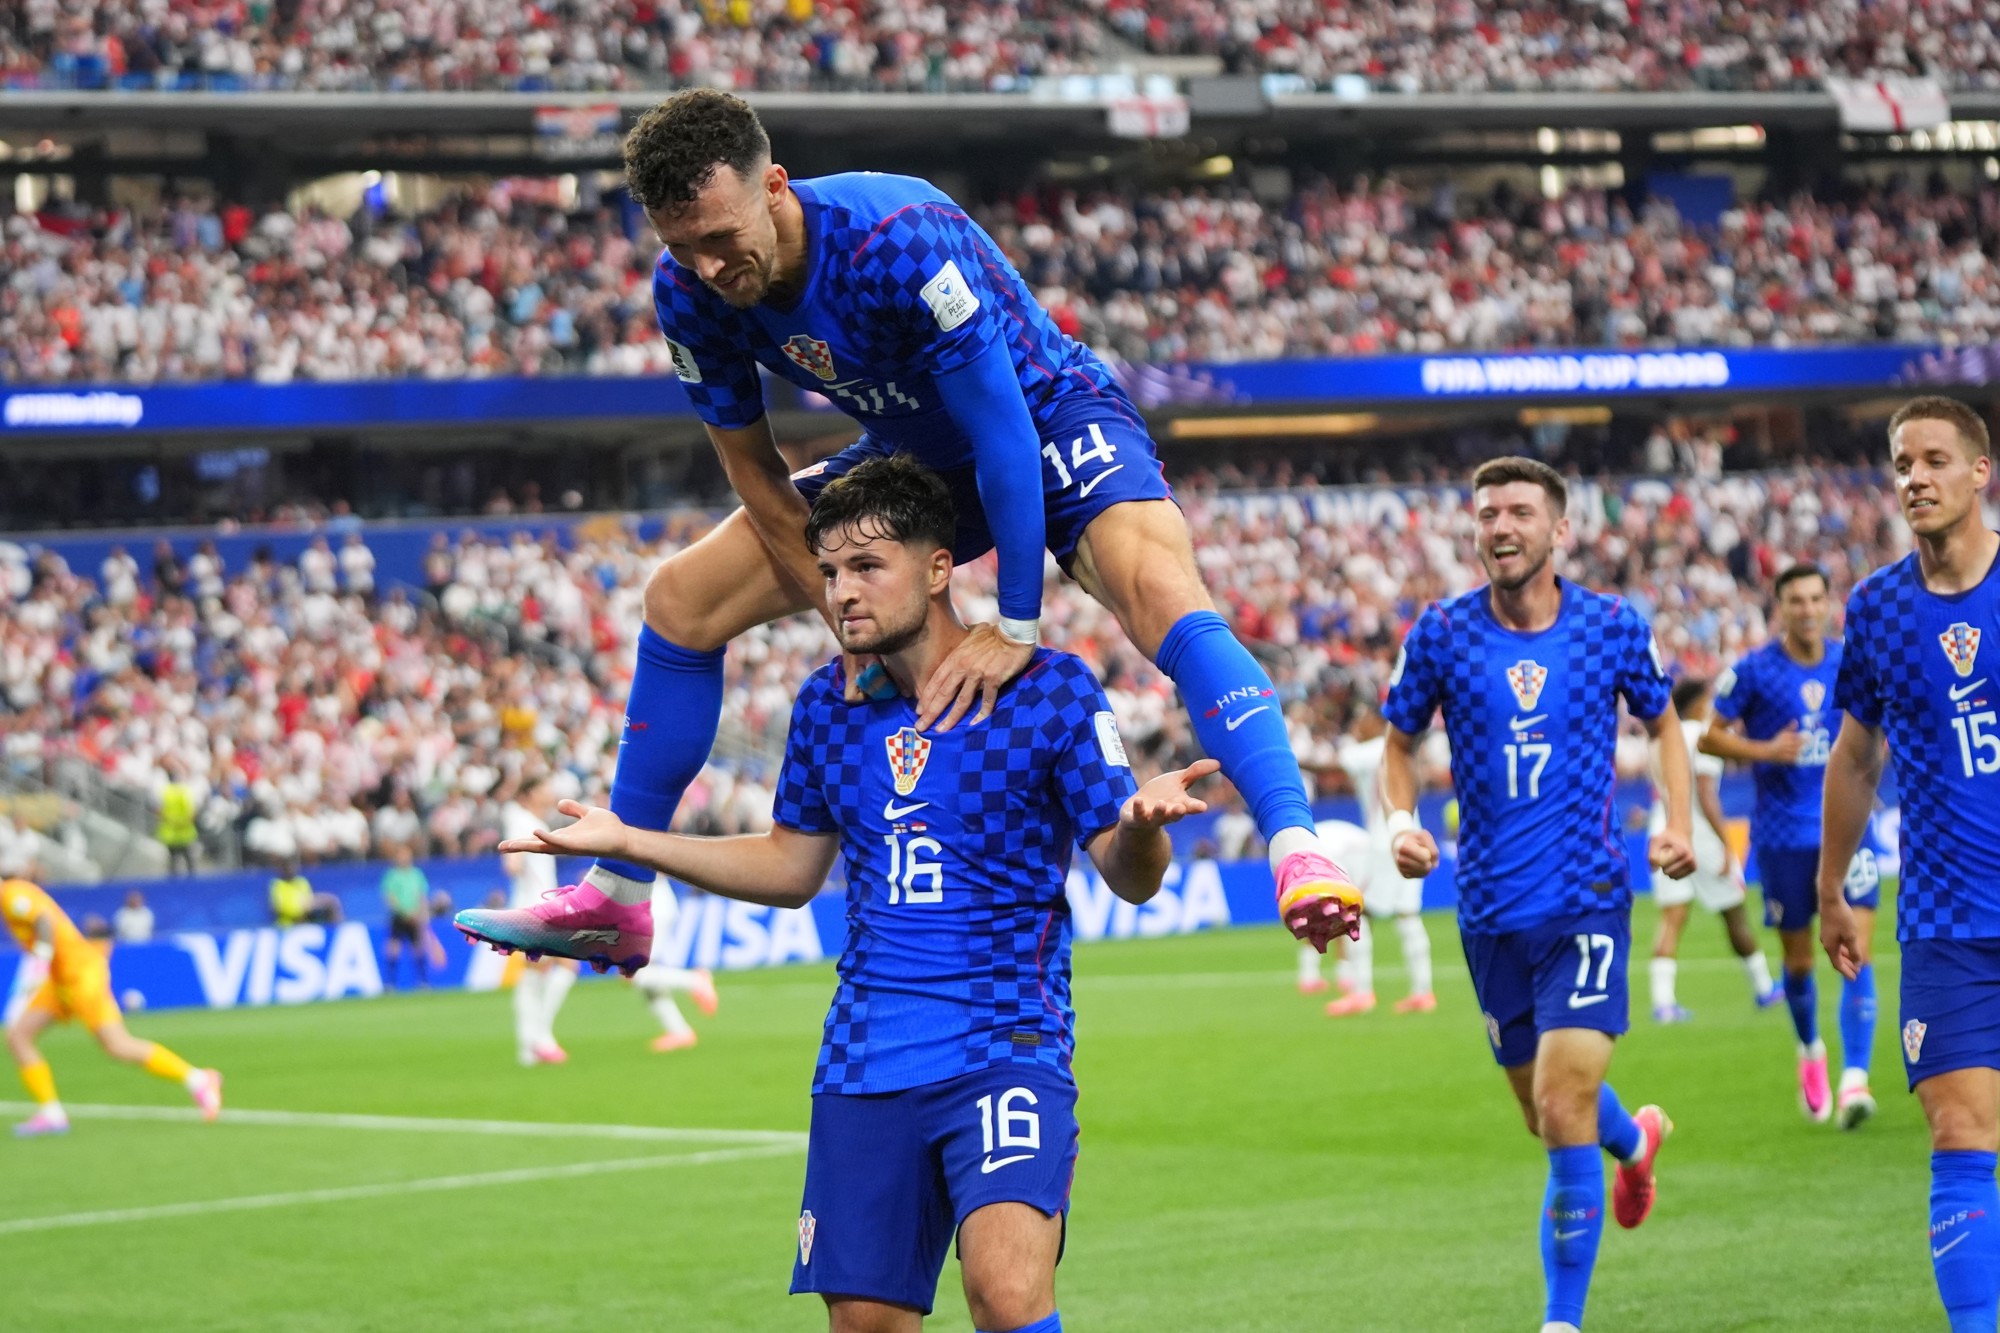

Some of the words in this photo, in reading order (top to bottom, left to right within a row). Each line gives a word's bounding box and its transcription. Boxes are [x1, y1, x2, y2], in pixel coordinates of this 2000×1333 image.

[948, 296, 968, 317] PEACE
[1422, 357, 1486, 393] FIFA
[1485, 355, 1583, 391] WORLD
[1581, 353, 1637, 390] CUP
[1041, 424, 1117, 489] 14
[1216, 685, 1261, 710] HNS
[1503, 743, 1553, 799] 17
[1951, 710, 2000, 779] 15
[883, 834, 944, 905] 16
[173, 921, 384, 1009] VISA
[1575, 933, 1615, 991] 17
[976, 1086, 1041, 1154] 16
[1932, 1209, 1969, 1236] HNS
